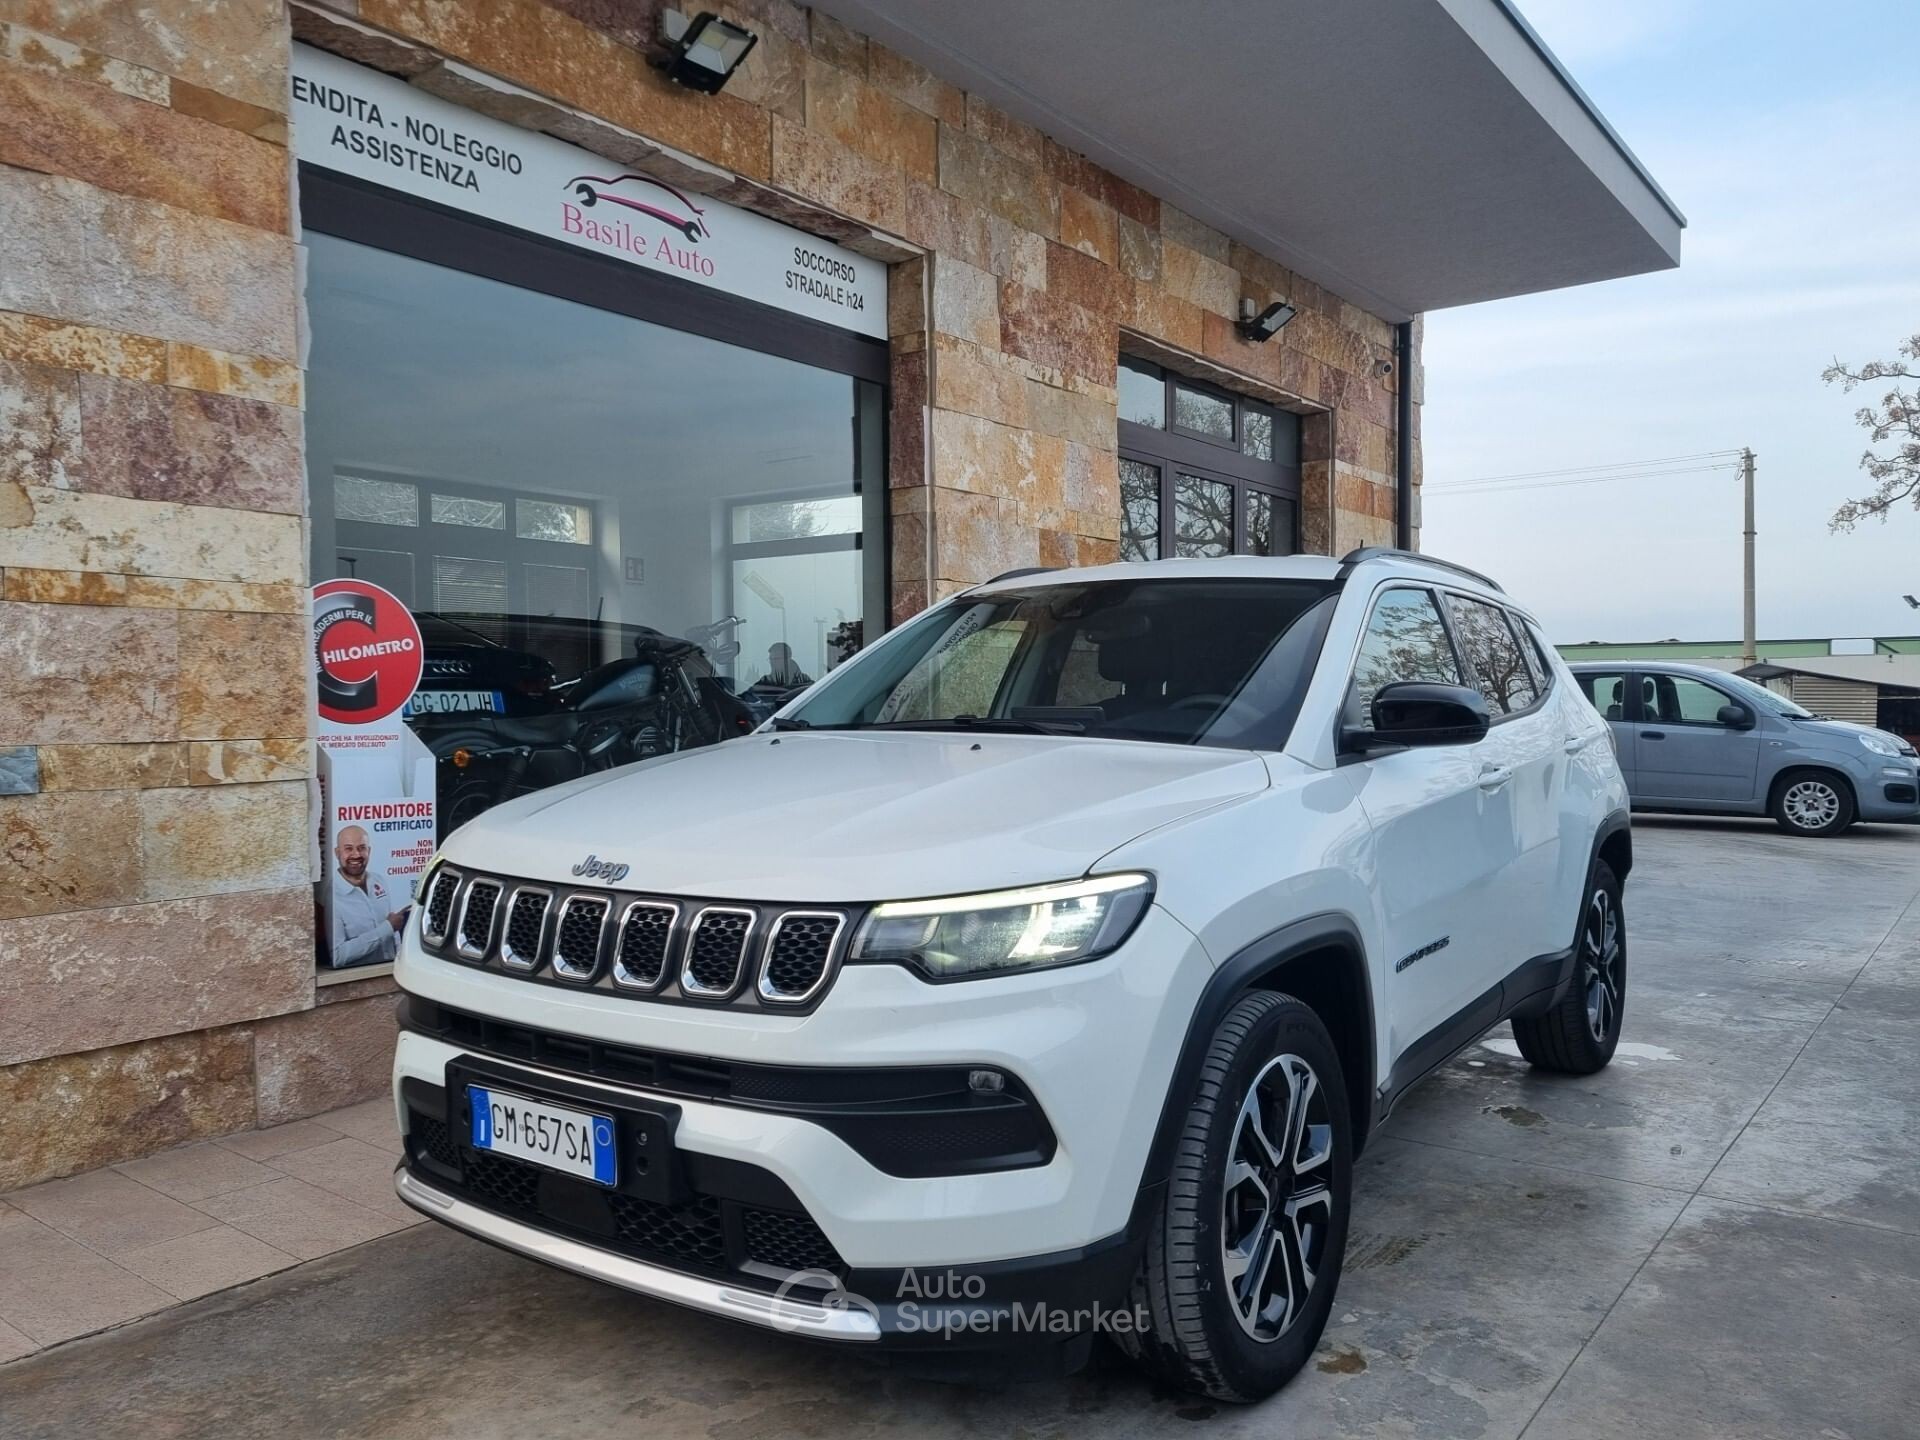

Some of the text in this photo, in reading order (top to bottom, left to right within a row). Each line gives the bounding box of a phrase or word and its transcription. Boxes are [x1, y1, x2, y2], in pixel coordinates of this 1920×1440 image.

[292, 75, 384, 128] ENDITA
[406, 115, 522, 175] NOLEGGIO
[331, 124, 480, 193] ASSISTENZA
[561, 202, 714, 277] Basile Auto
[794, 247, 855, 284] SOCCORSO
[785, 270, 864, 312] STRADALE h24
[345, 609, 364, 620] PER
[338, 802, 433, 821] RIVENDITORE
[374, 819, 433, 832] CERTIFICATO
[391, 847, 433, 858] PRENDERMI
[417, 839, 433, 848] NON
[387, 864, 426, 876] CHILOMET
[412, 856, 426, 865] PER
[572, 854, 630, 885] Jeep
